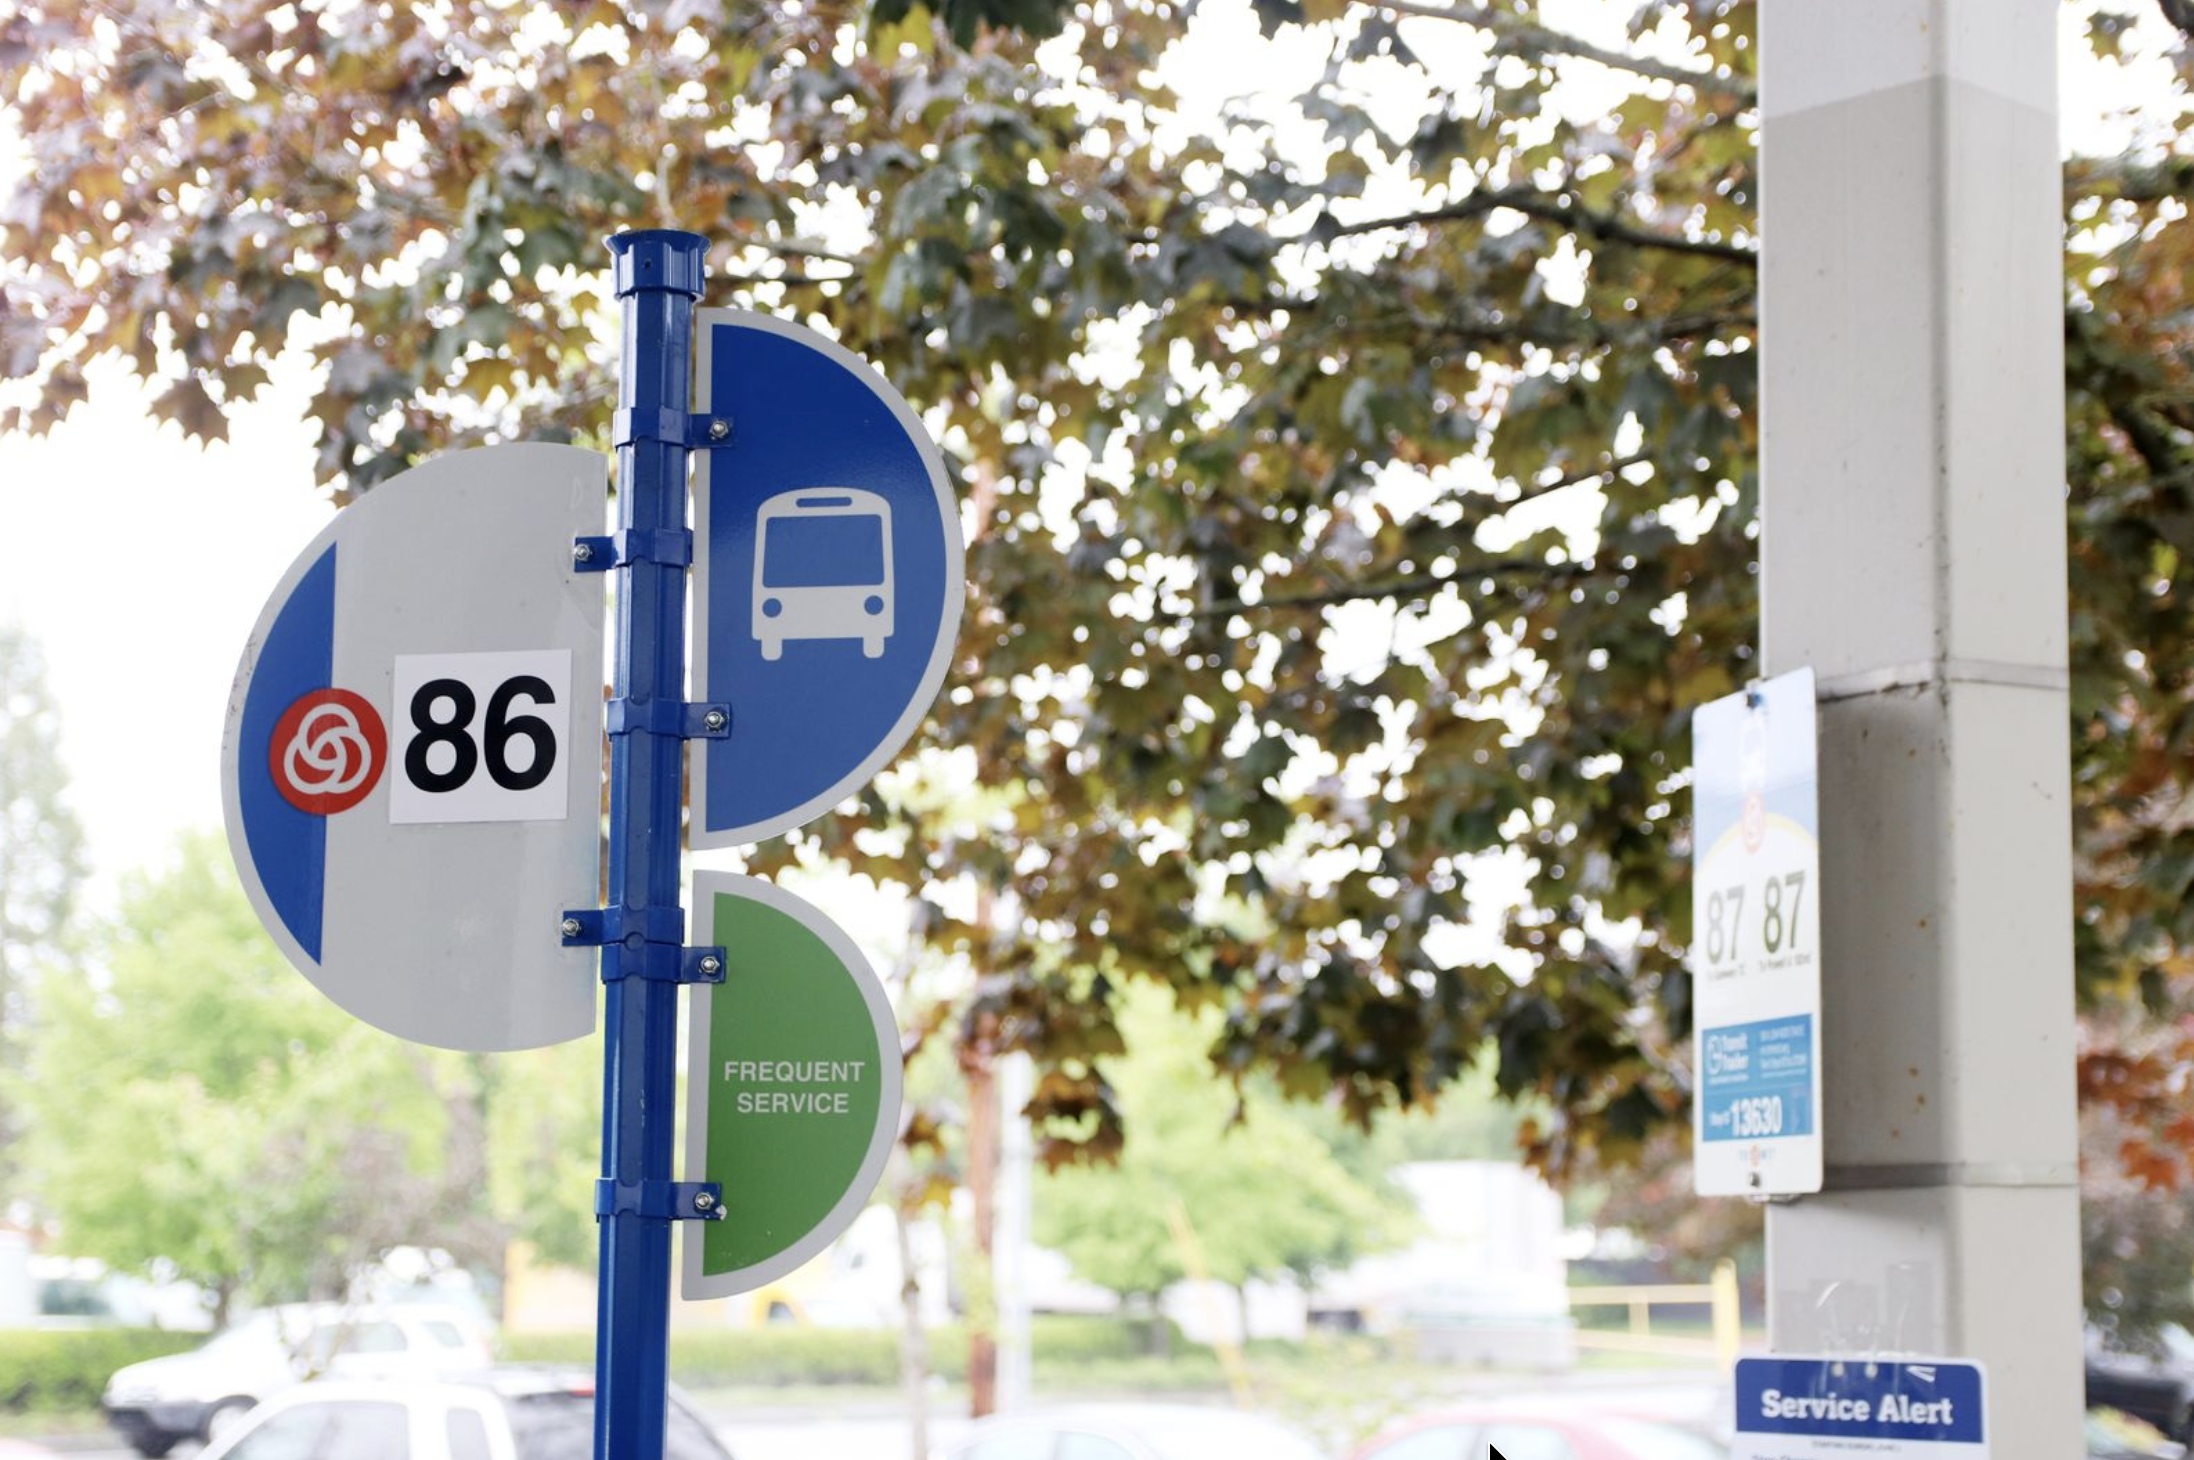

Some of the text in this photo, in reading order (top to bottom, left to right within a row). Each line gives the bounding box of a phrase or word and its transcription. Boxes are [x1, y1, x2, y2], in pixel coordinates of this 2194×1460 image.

[405, 675, 556, 793] 86
[1706, 870, 1805, 964] 87 87
[724, 1061, 865, 1082] FREQUENT
[737, 1092, 849, 1113] SERVICE
[1730, 1095, 1783, 1137] 13630
[1761, 1388, 1954, 1425] Service Alert
